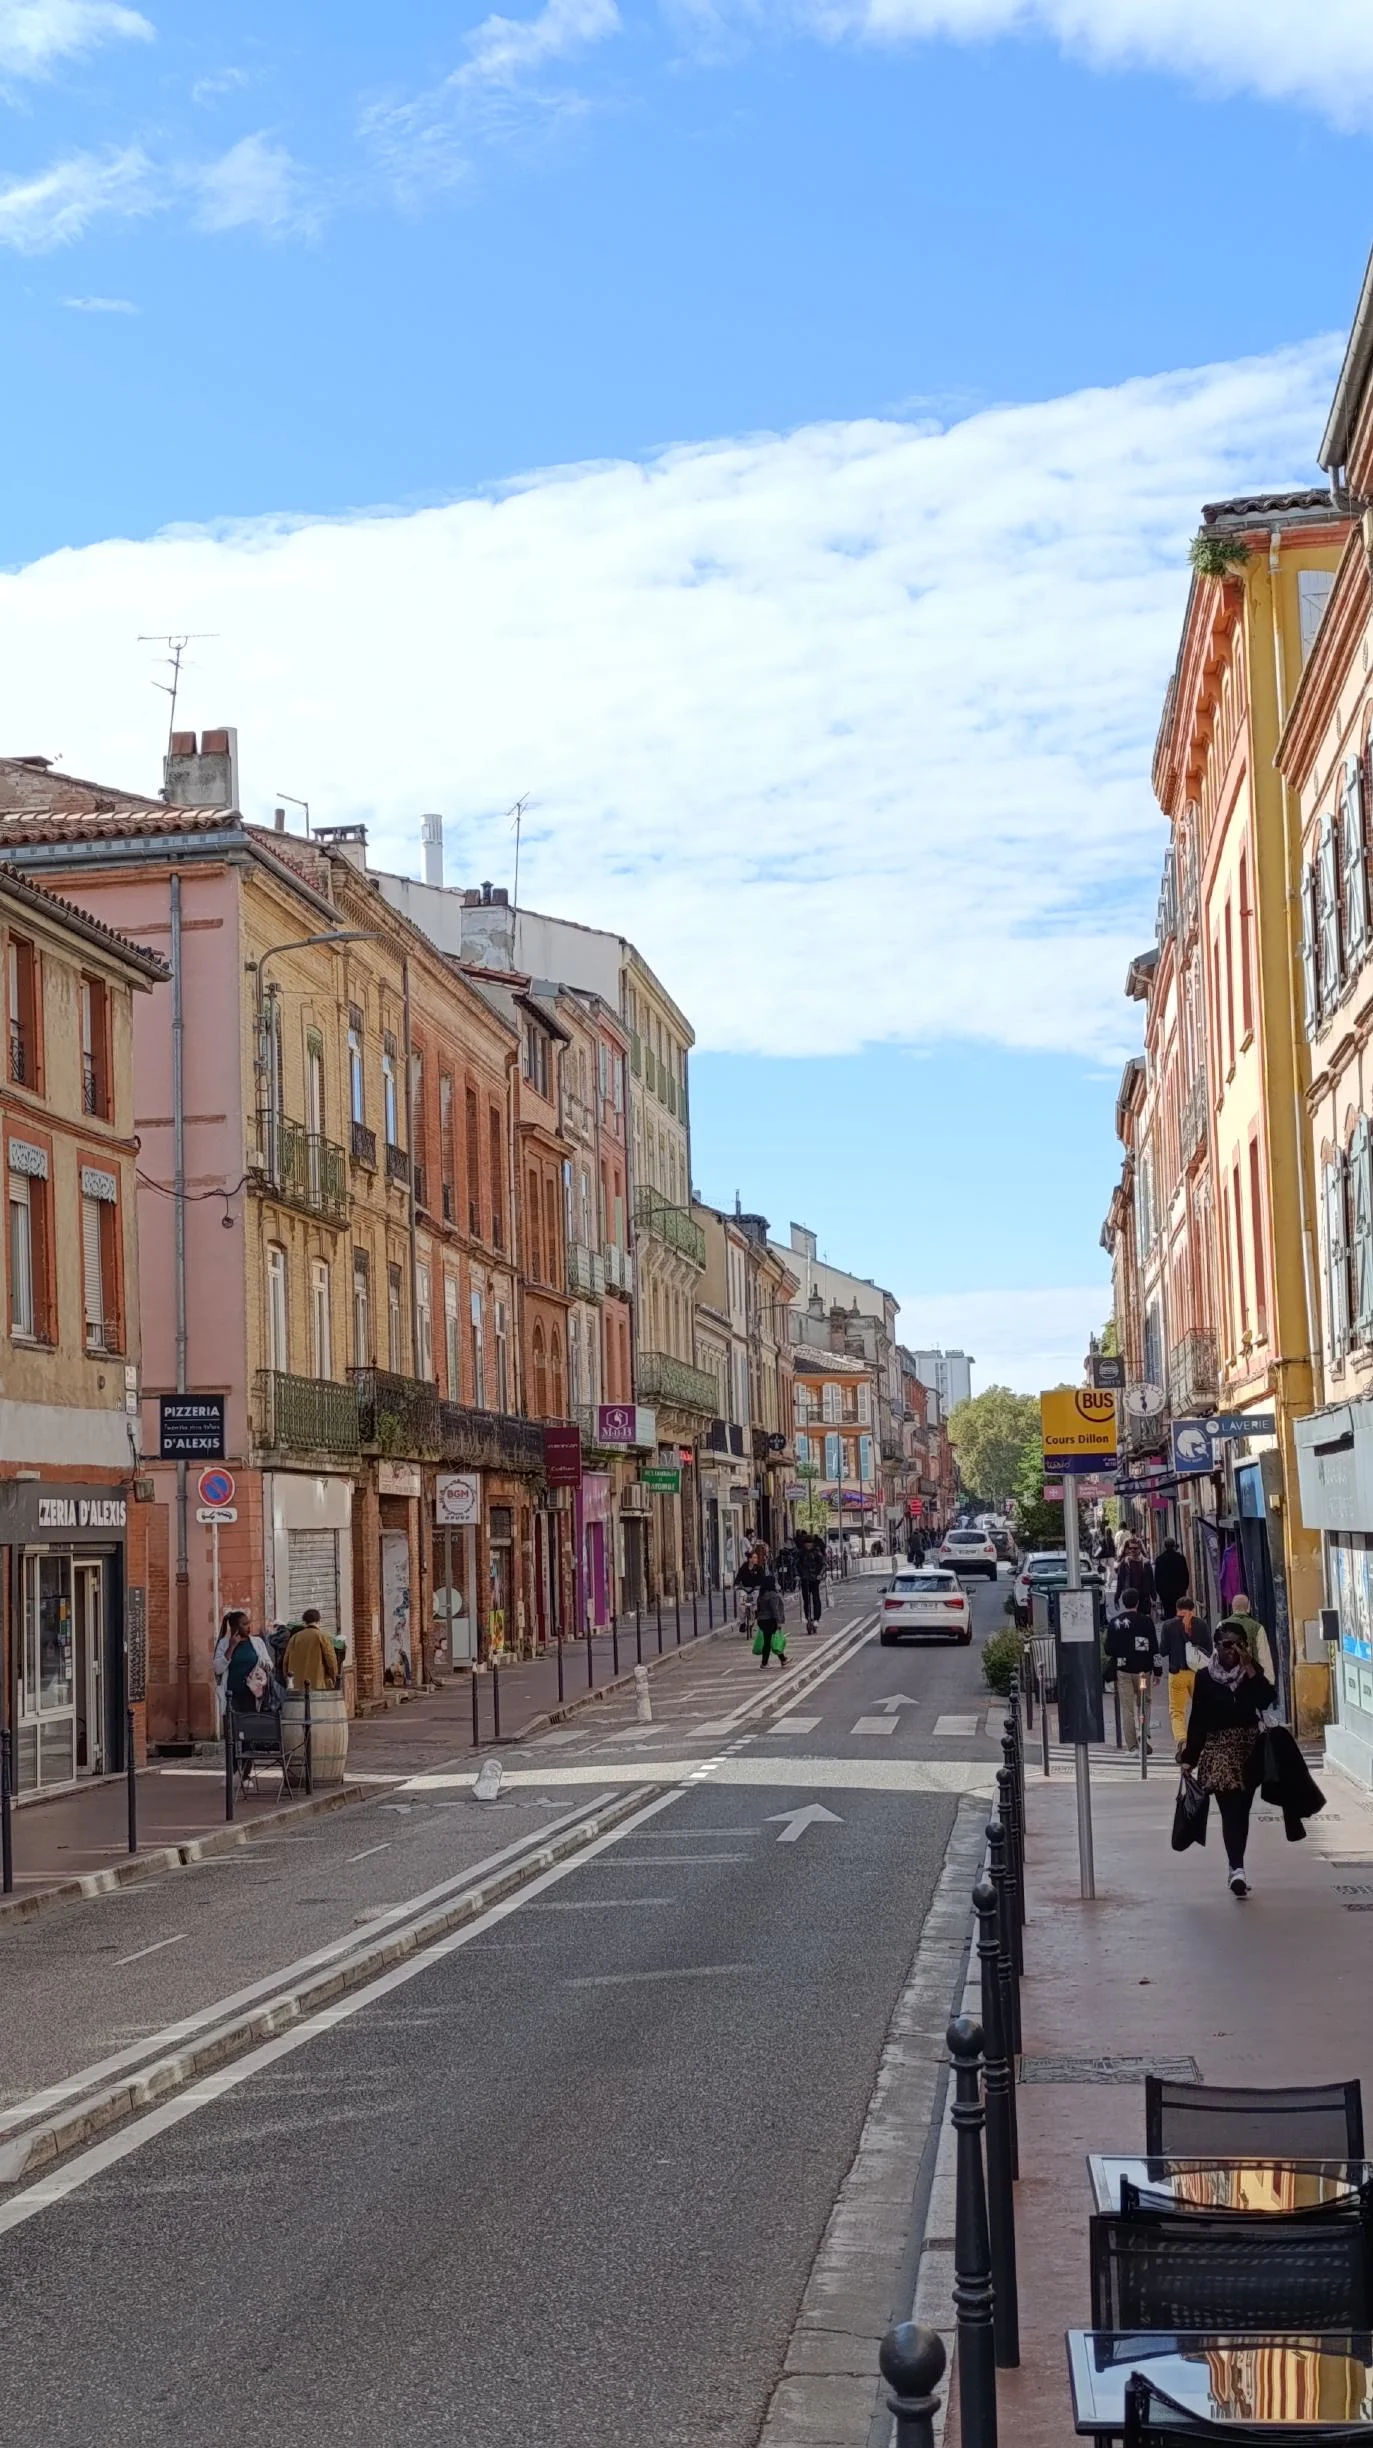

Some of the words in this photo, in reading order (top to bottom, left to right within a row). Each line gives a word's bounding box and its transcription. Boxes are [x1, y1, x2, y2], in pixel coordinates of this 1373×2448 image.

[1083, 1393, 1114, 1408] BUS
[164, 1405, 220, 1417] PIZZERIA
[1222, 1420, 1270, 1432] LAVERIE
[164, 1438, 220, 1449] D'ALEXIS
[1045, 1436, 1075, 1445] Cours
[1078, 1433, 1109, 1444] Dillon
[447, 1489, 468, 1498] BGM
[80, 1500, 126, 1528] D'ALEXIS
